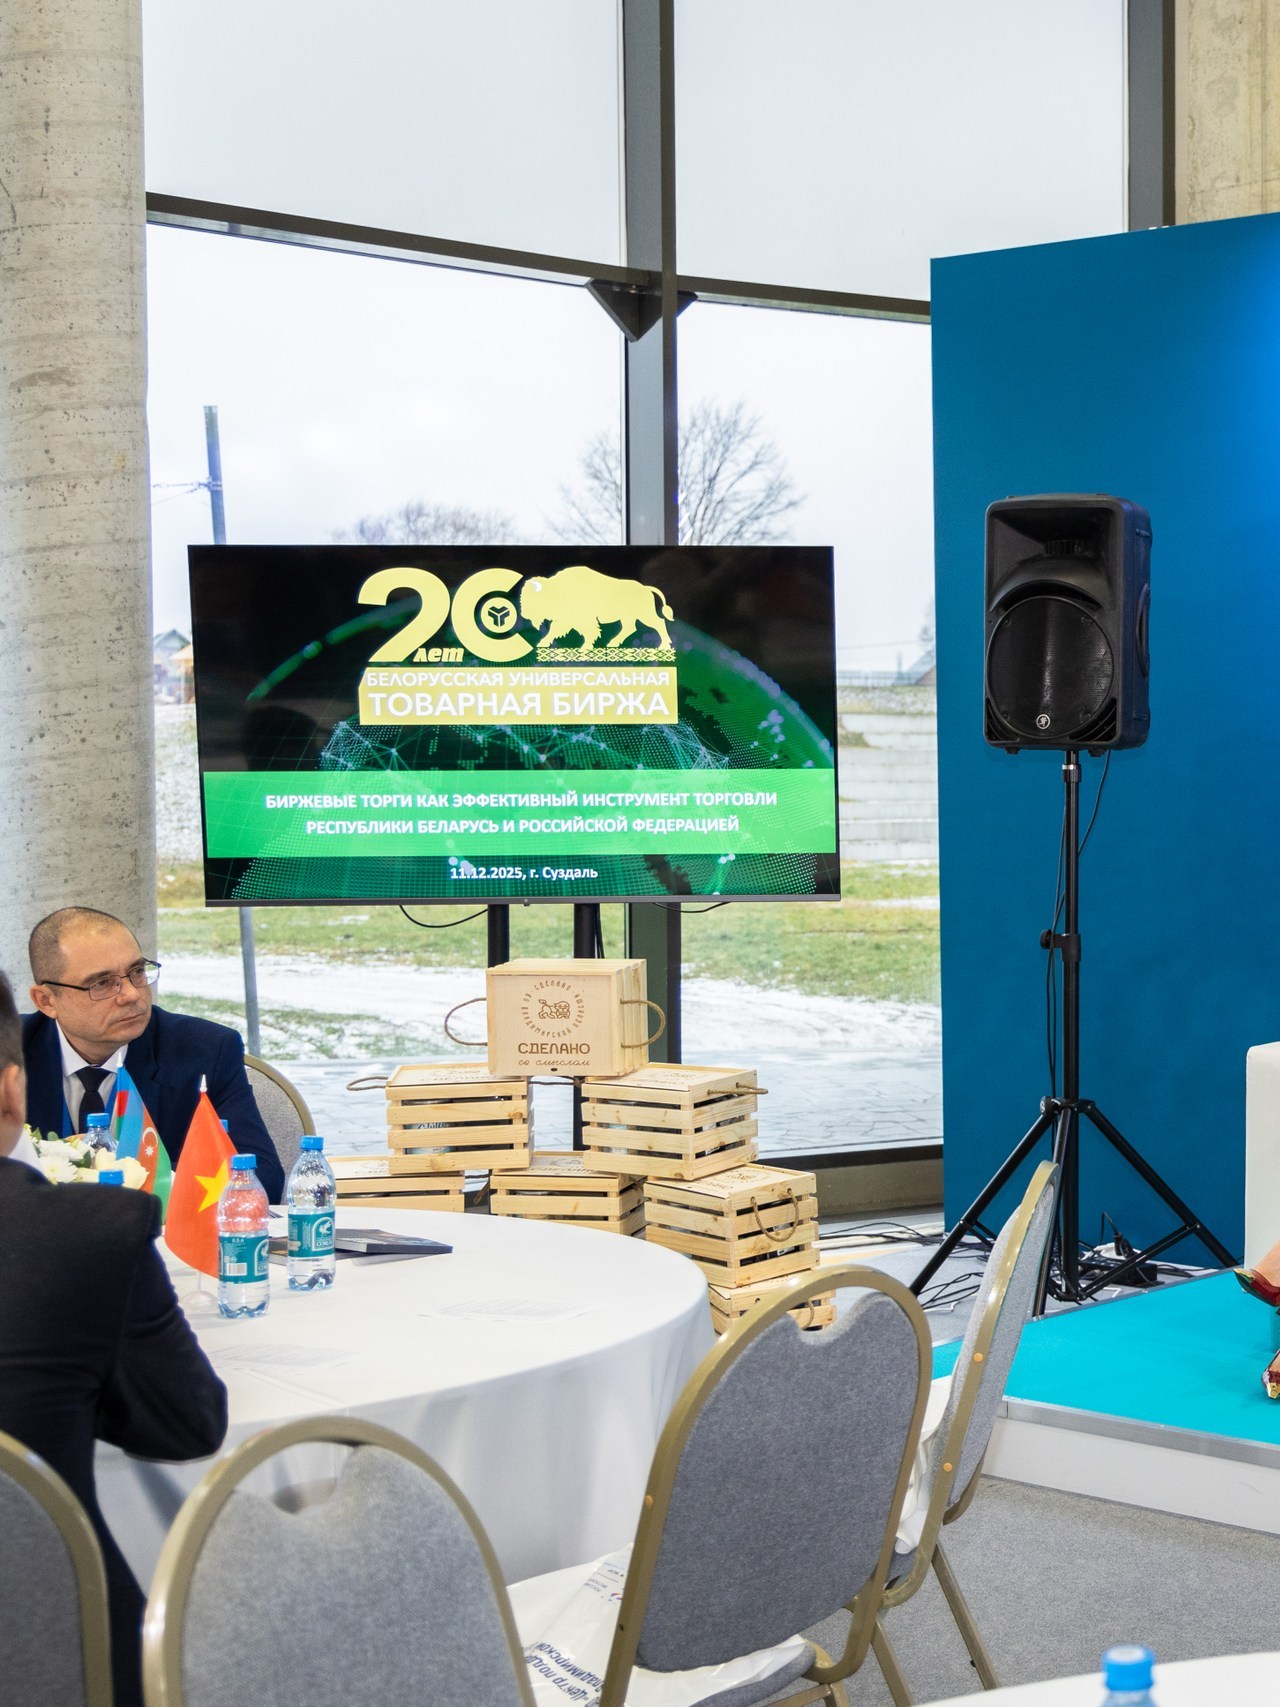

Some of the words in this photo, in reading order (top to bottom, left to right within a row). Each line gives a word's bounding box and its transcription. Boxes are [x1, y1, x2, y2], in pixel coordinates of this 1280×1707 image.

[412, 647, 465, 663] лет
[366, 671, 504, 687] БЕЛОРУССКАЯ
[508, 671, 670, 687] УНИВЕРСАЛЬНАЯ
[368, 692, 542, 716] ТОВАРНАЯ
[553, 692, 670, 716] БИРЖА
[265, 794, 358, 809] БИРЖЕВЫЕ
[360, 794, 414, 808] ТОРГИ
[416, 794, 450, 808] КАК
[452, 790, 579, 808] ЭФФЕКТИВНЫЙ
[582, 792, 690, 808] ИНСТРУМЕНТ
[693, 792, 778, 806] ТОРГОВЛИ
[306, 820, 414, 835] РЕСПУБЛИКИ
[417, 820, 500, 834] БЕЛАРУСЬ
[502, 820, 516, 834] И
[518, 816, 629, 833] РОССИЙСКОЙ
[631, 815, 740, 834] ФЕДЕРАЦИЕЙ
[450, 867, 527, 881] 11.12.2025,
[529, 870, 540, 879] г.
[542, 867, 599, 881] Суздаль
[518, 1043, 591, 1055] СДЕЛАНО
